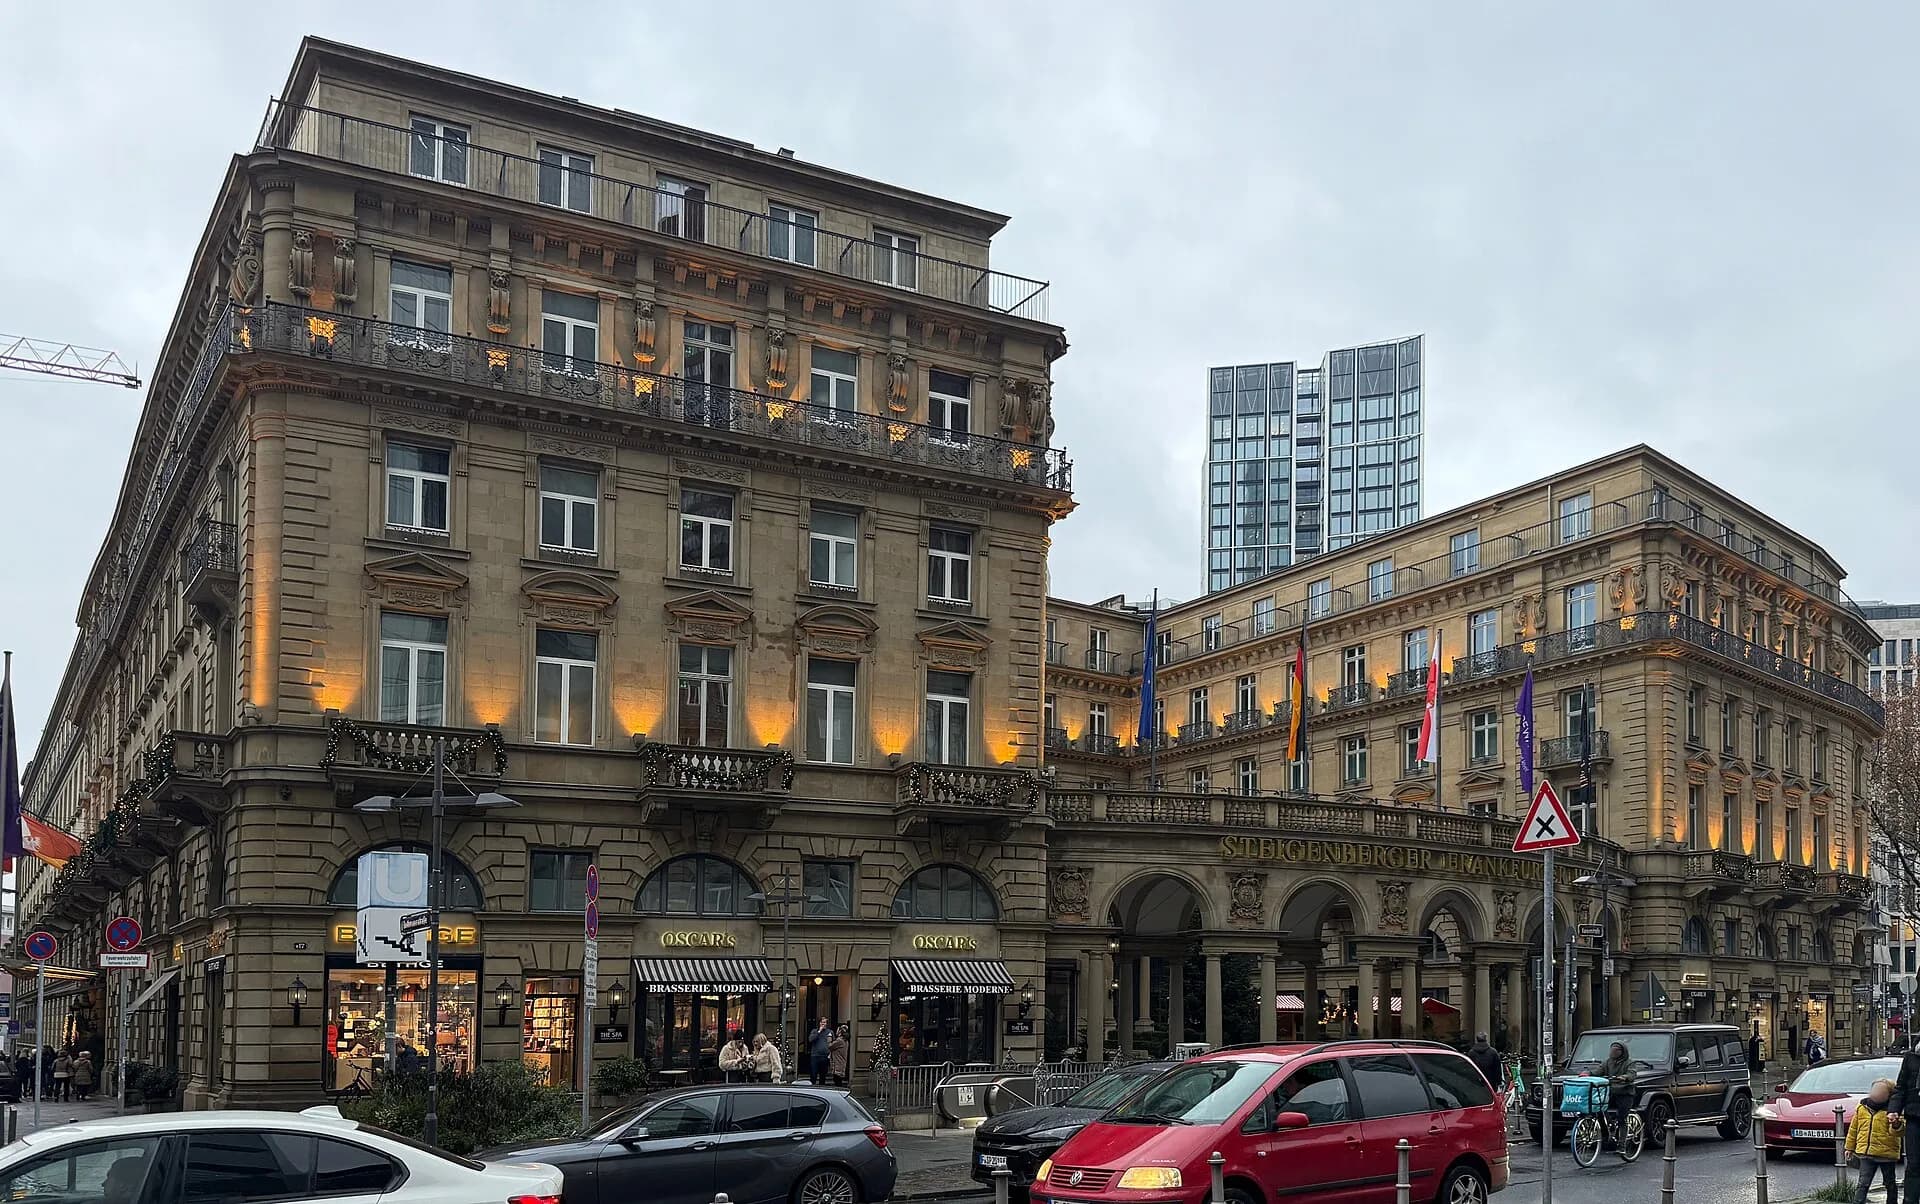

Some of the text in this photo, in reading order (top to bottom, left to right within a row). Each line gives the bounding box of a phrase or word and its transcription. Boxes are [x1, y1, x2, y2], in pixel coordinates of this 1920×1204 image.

[1222, 835, 1431, 870] STEIGENBERGER
[375, 857, 424, 903] U
[649, 984, 768, 993] BRASSERIE MODERNE
[910, 984, 1010, 994] BRASSERIE MODERNE
